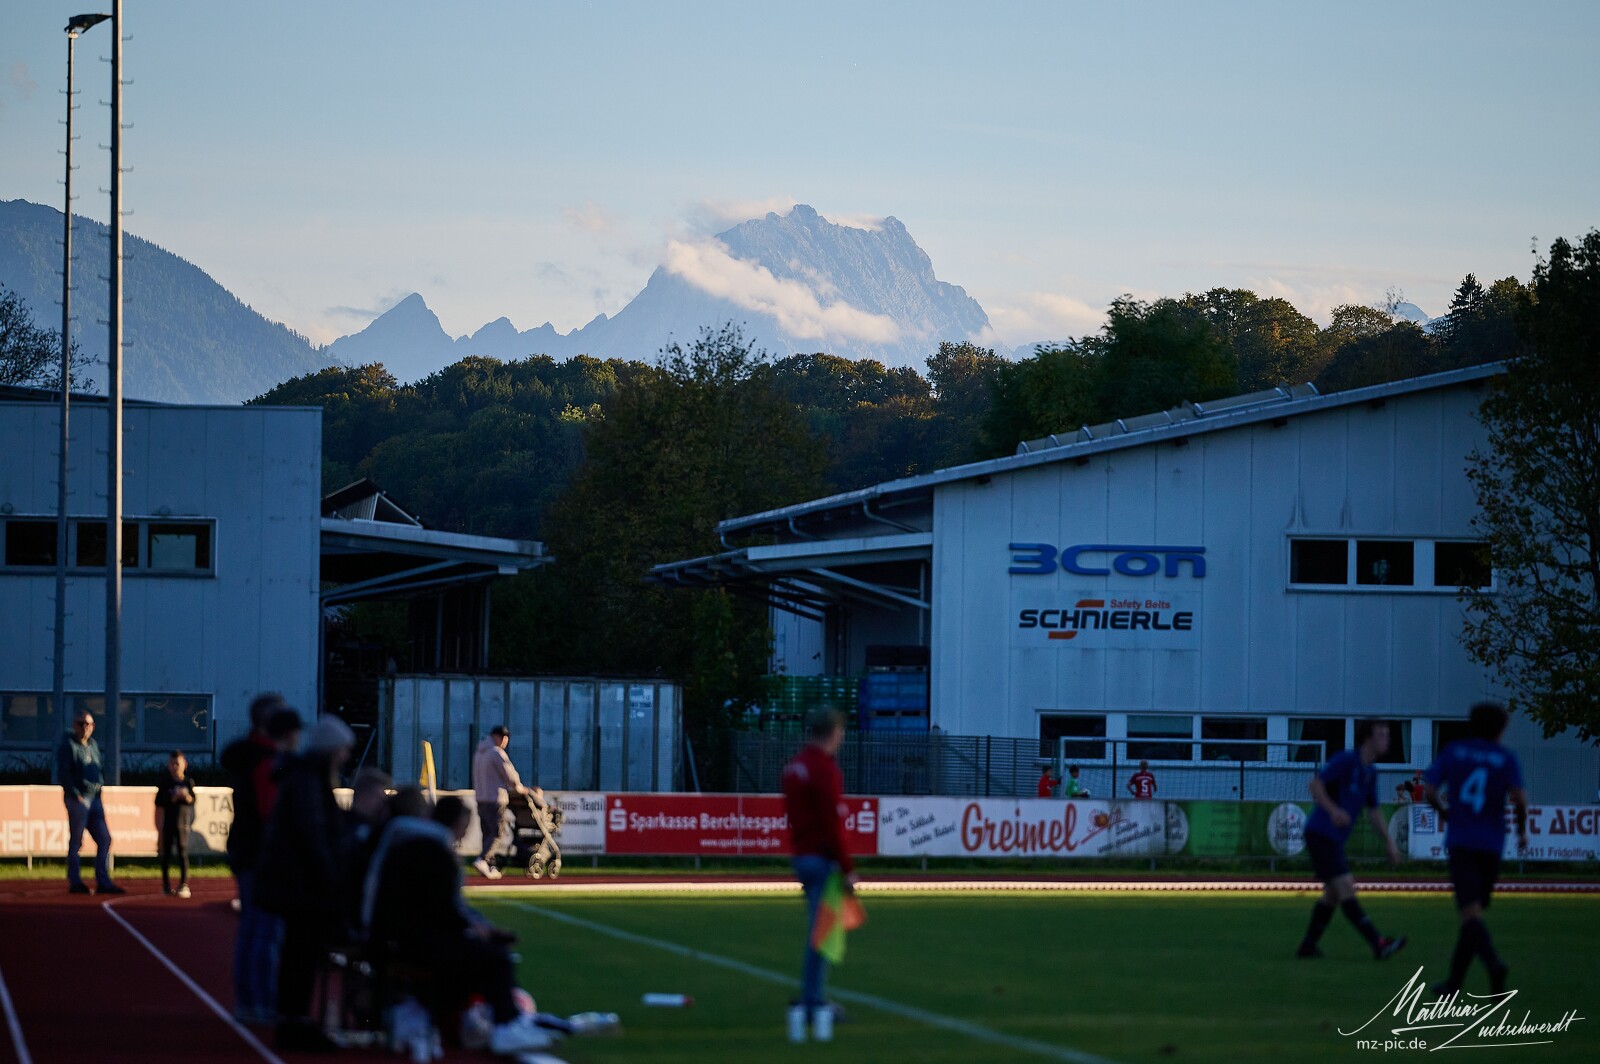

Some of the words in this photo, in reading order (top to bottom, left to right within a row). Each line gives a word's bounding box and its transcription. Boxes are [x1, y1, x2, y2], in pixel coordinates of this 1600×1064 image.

[1110, 599, 1142, 610] Safety
[1145, 600, 1171, 609] Belts
[1018, 607, 1193, 632] SCHNIERLE
[1459, 768, 1488, 814] 4
[629, 811, 698, 832] Sparkasse
[699, 811, 793, 834] Berchtesgad
[960, 802, 1079, 852] Greimel
